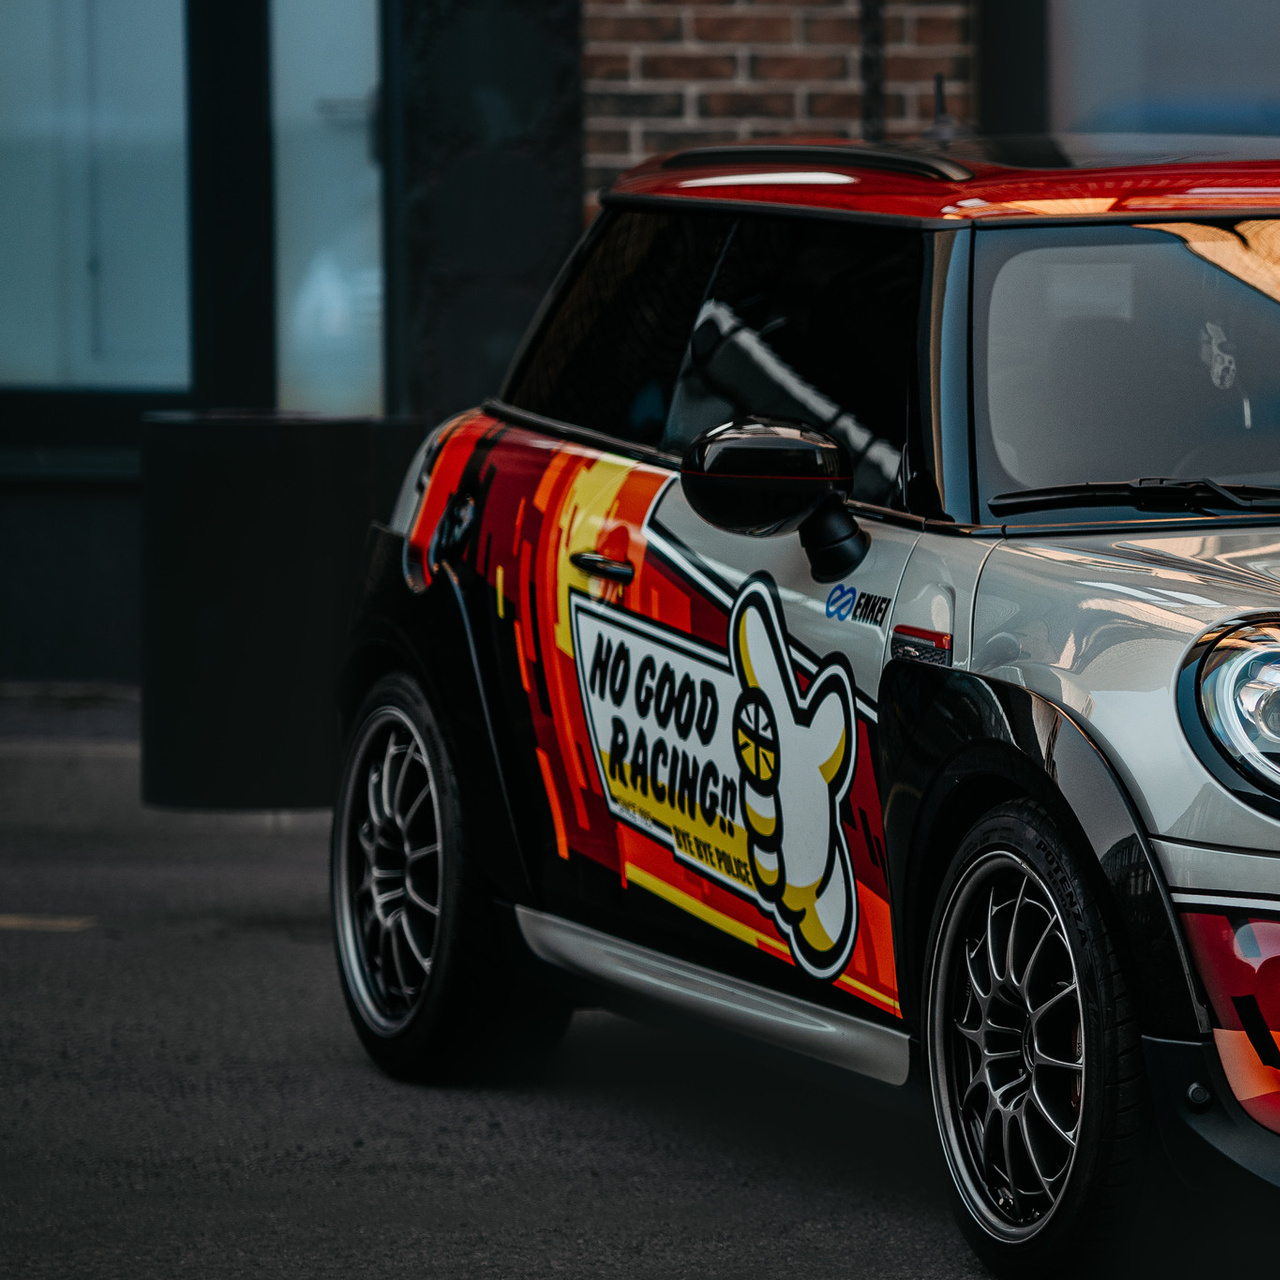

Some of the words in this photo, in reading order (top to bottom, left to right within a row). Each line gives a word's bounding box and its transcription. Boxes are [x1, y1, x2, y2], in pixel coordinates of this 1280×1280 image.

[851, 592, 892, 627] ENKEI
[589, 630, 631, 709] NO
[634, 653, 719, 747] GOOD
[673, 824, 695, 856] BYE
[694, 835, 717, 868] BYE
[714, 846, 754, 887] POLICE
[1034, 839, 1089, 948] POTENZA
